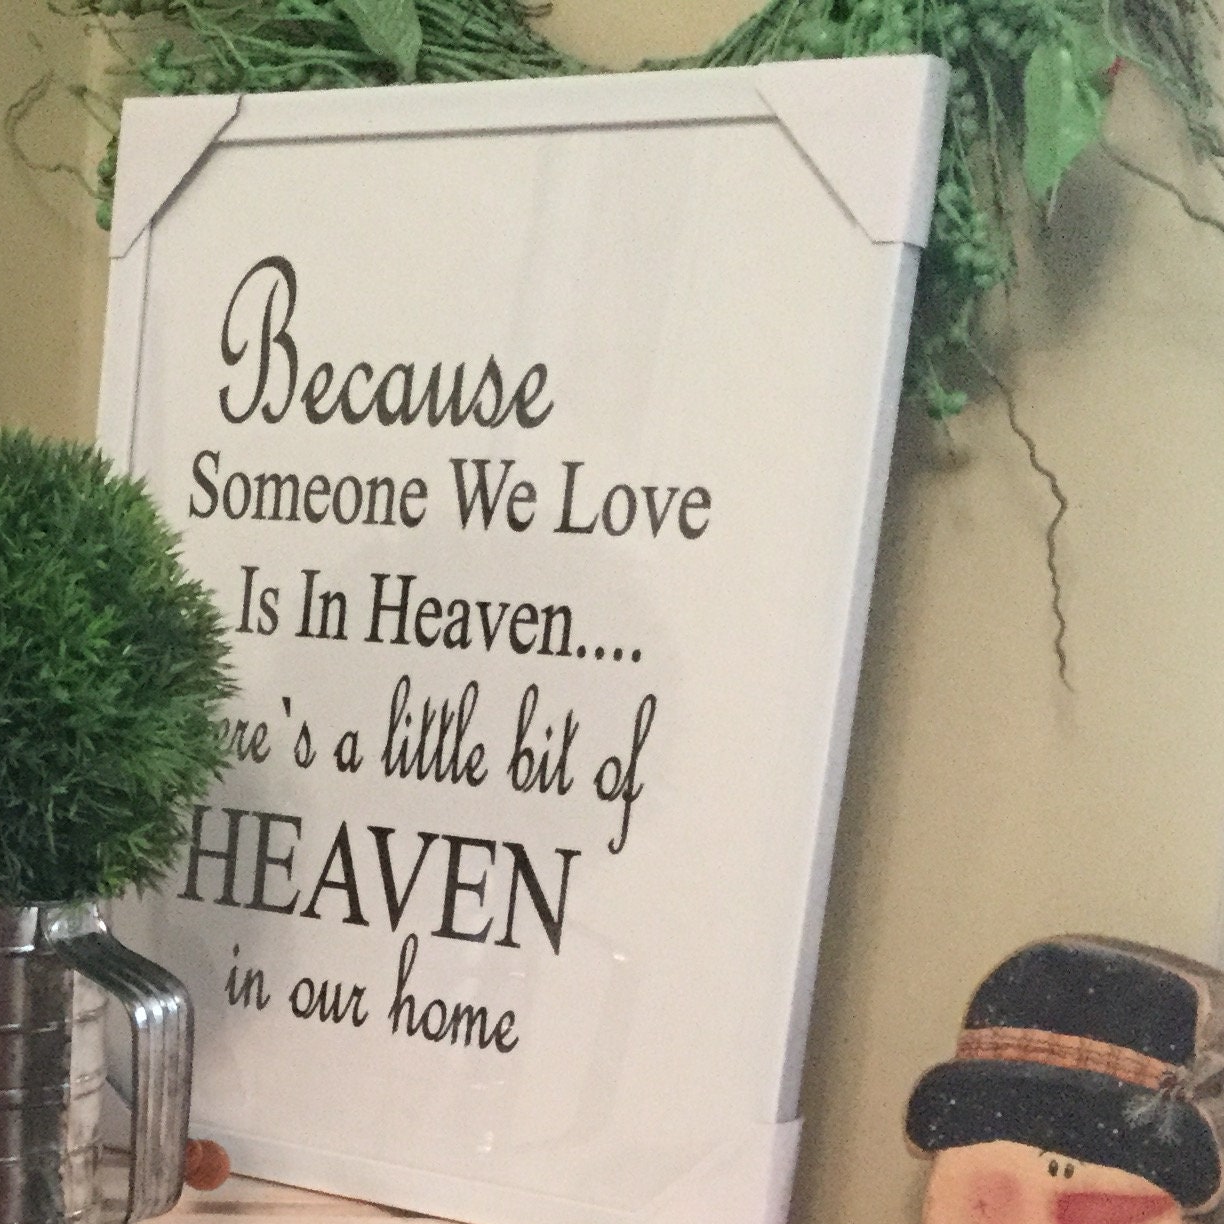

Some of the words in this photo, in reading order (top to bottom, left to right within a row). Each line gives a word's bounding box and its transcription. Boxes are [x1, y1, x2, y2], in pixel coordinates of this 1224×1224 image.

[219, 255, 554, 429] Because
[189, 450, 428, 527] Someone
[449, 458, 537, 532] We
[553, 461, 712, 539] Love
[235, 566, 279, 636] Is
[295, 569, 348, 640] In
[333, 728, 364, 773] a
[381, 674, 488, 788] little
[507, 684, 579, 796] bit
[594, 694, 657, 854] of
[177, 804, 581, 955] HEAVEN
[225, 944, 271, 1011] in
[288, 976, 369, 1027] our
[388, 933, 519, 1053] home
